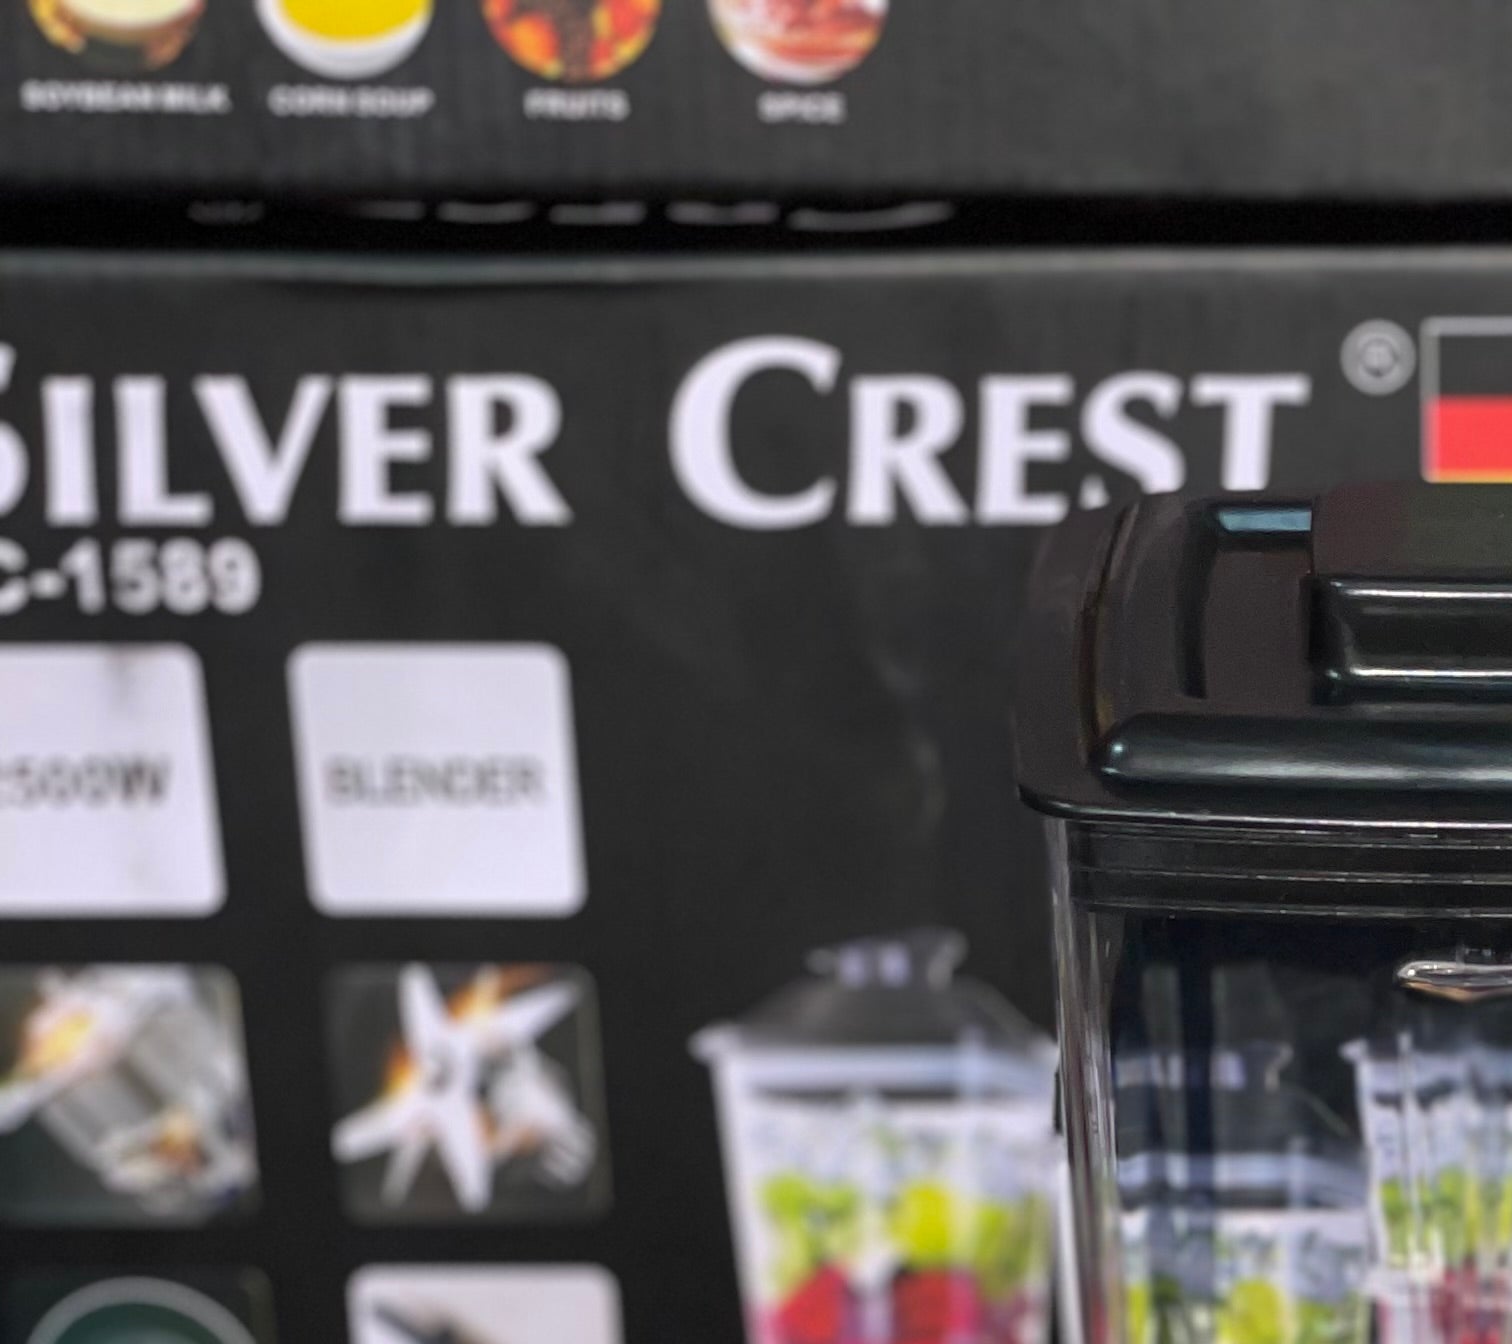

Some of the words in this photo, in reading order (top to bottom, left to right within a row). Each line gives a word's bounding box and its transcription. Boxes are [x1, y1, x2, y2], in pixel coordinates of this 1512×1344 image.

[522, 87, 630, 121] FRUITS
[0, 343, 572, 527] ILVER
[668, 335, 1311, 531] CREST
[0, 756, 171, 807] 500W
[323, 755, 547, 806] BLENDER
